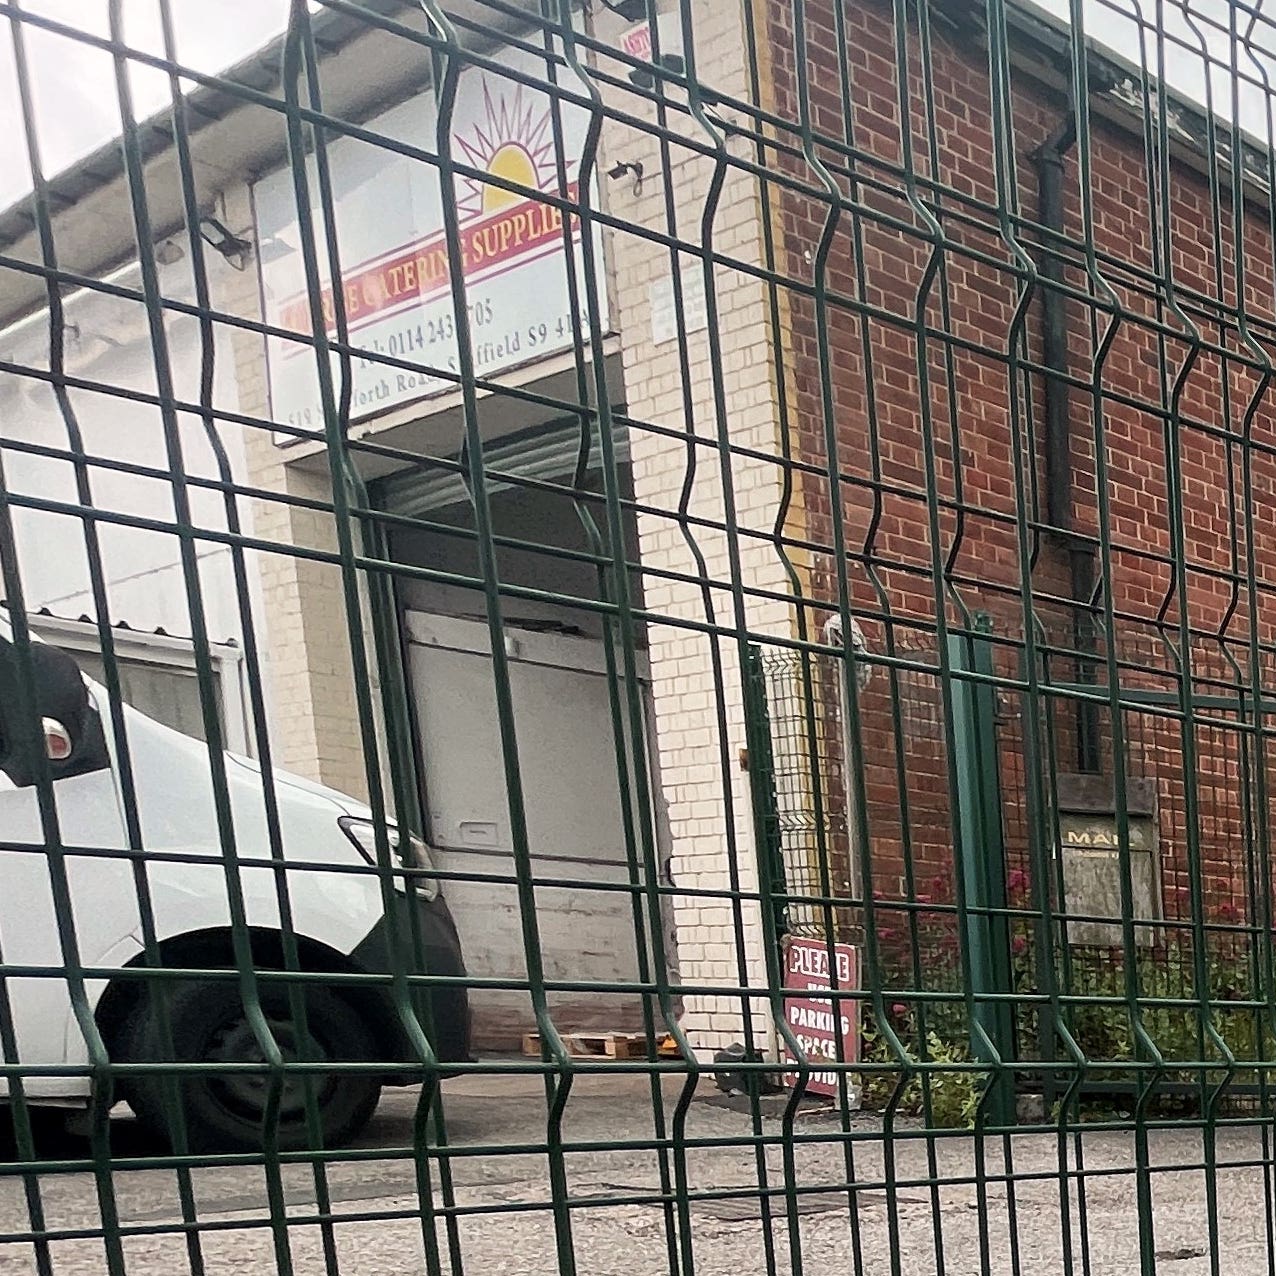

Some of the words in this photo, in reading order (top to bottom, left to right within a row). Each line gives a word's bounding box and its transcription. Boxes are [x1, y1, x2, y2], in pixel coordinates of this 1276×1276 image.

[388, 325, 424, 357] 0114
[427, 314, 454, 344] 243
[1067, 831, 1136, 847] MAI
[789, 946, 850, 982] PLEAE
[790, 1006, 850, 1036] PARKIG
